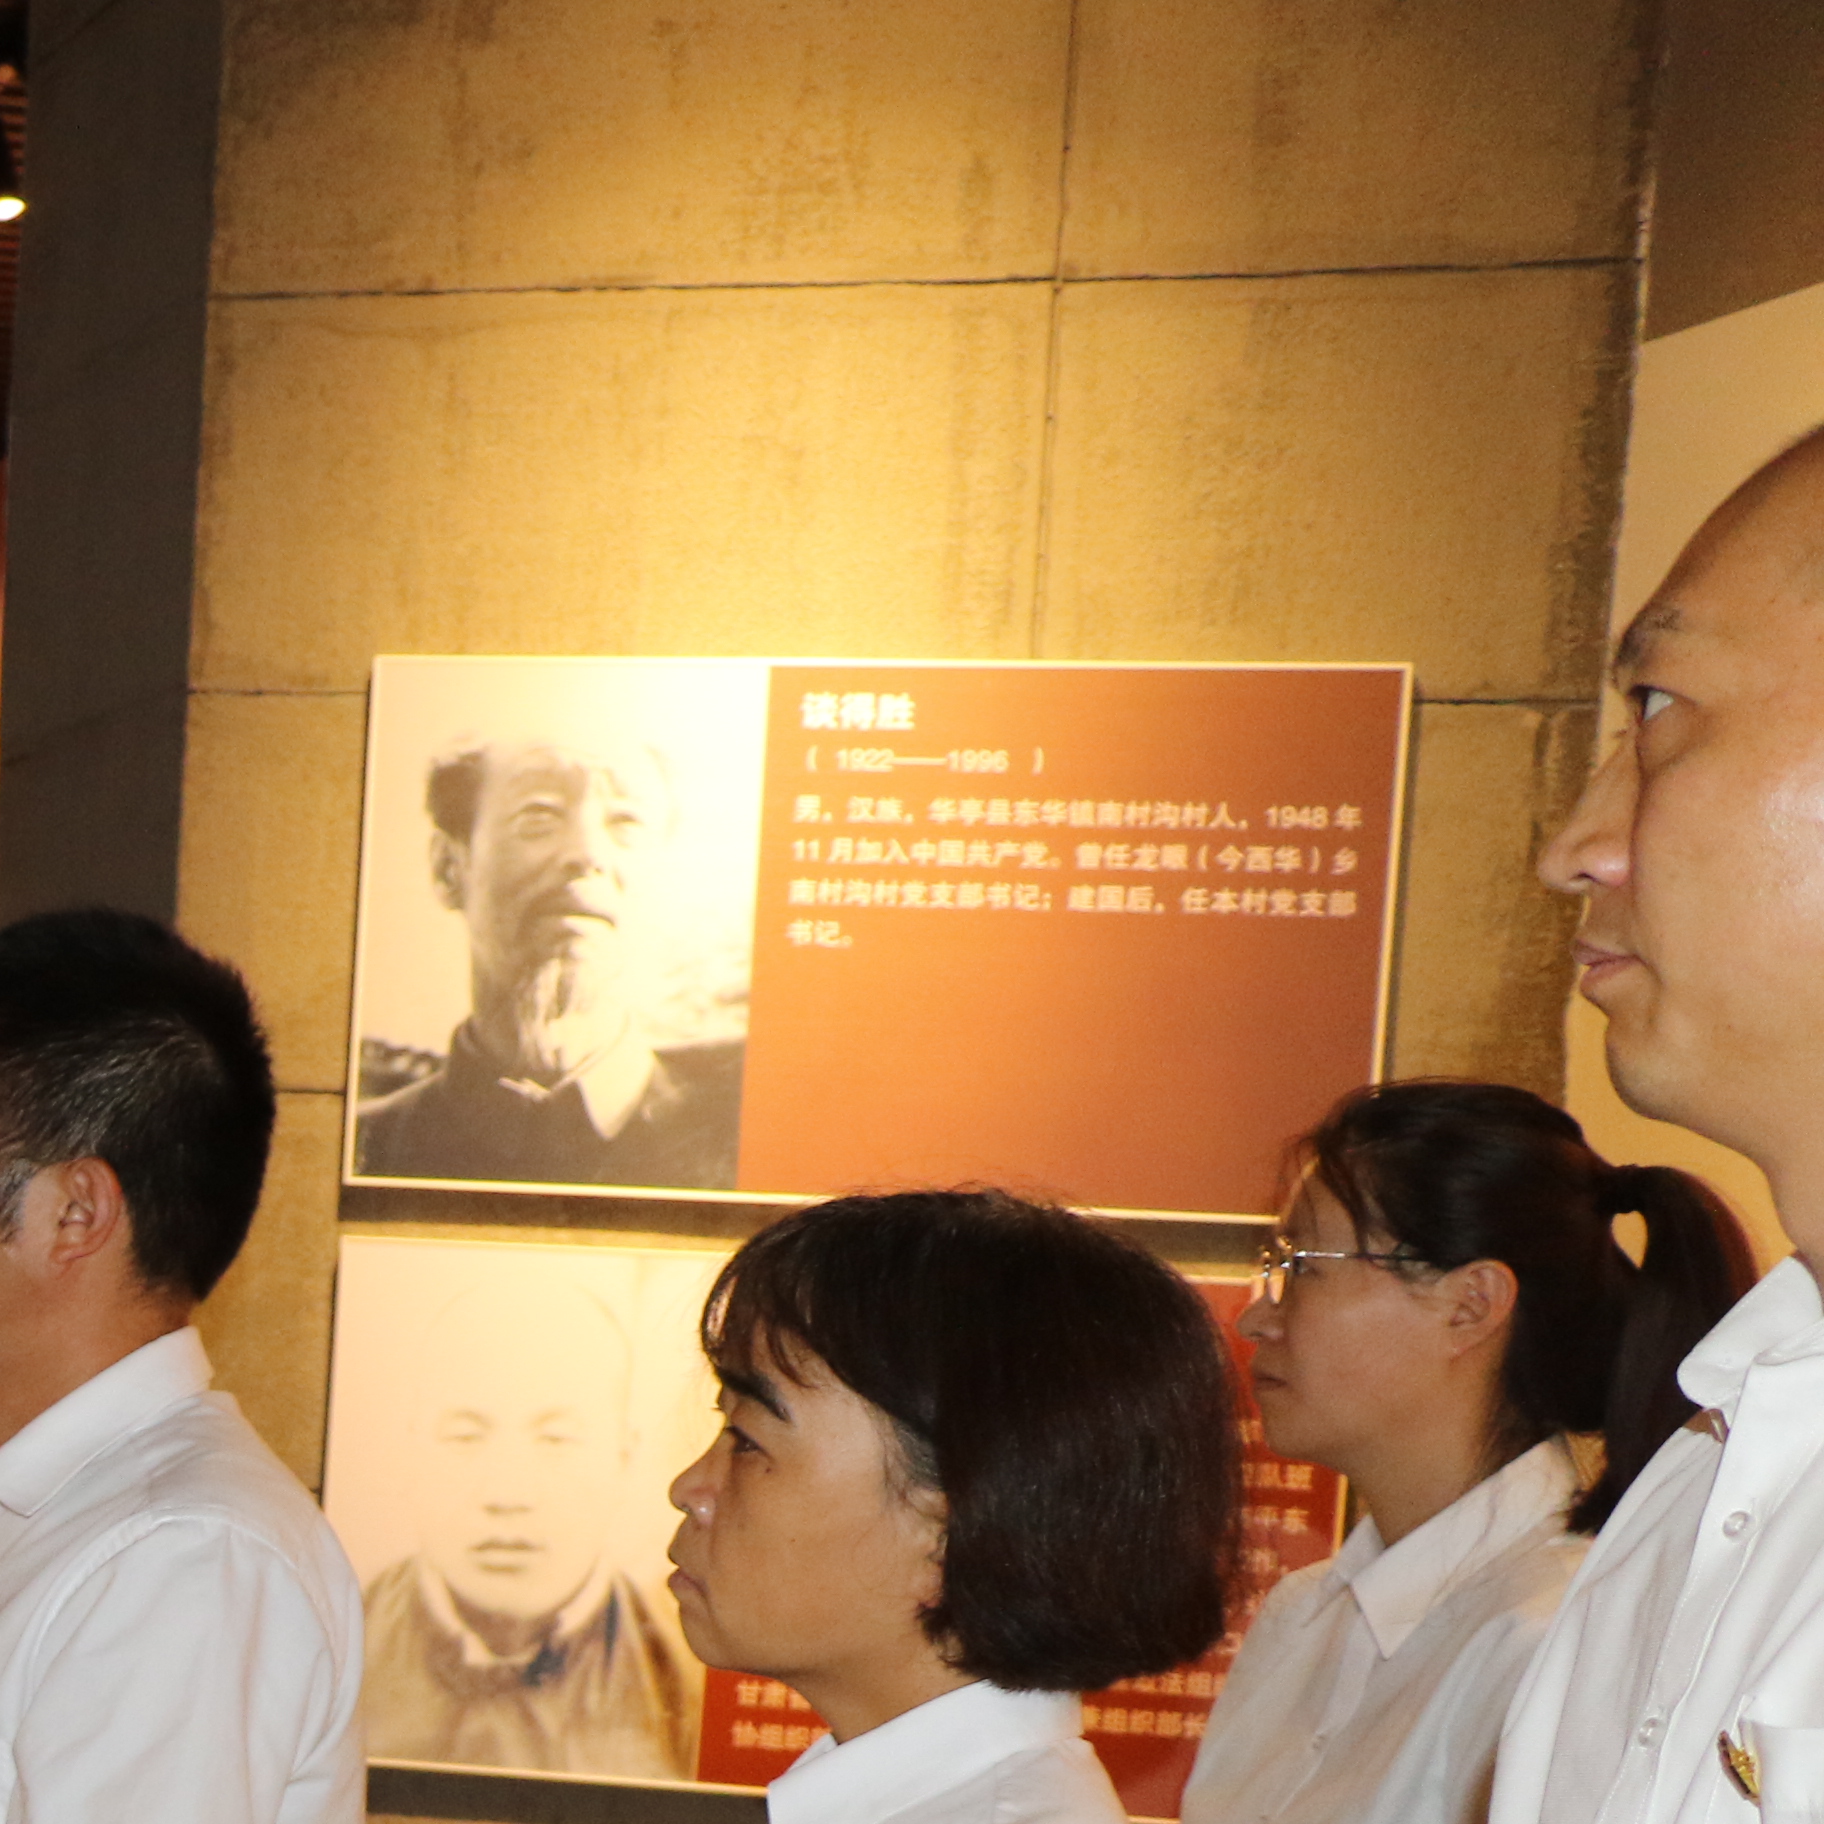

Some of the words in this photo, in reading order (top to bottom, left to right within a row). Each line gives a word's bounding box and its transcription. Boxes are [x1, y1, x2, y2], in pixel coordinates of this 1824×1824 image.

[800, 692, 915, 731] 谈得胜
[786, 920, 853, 947] 书记。
